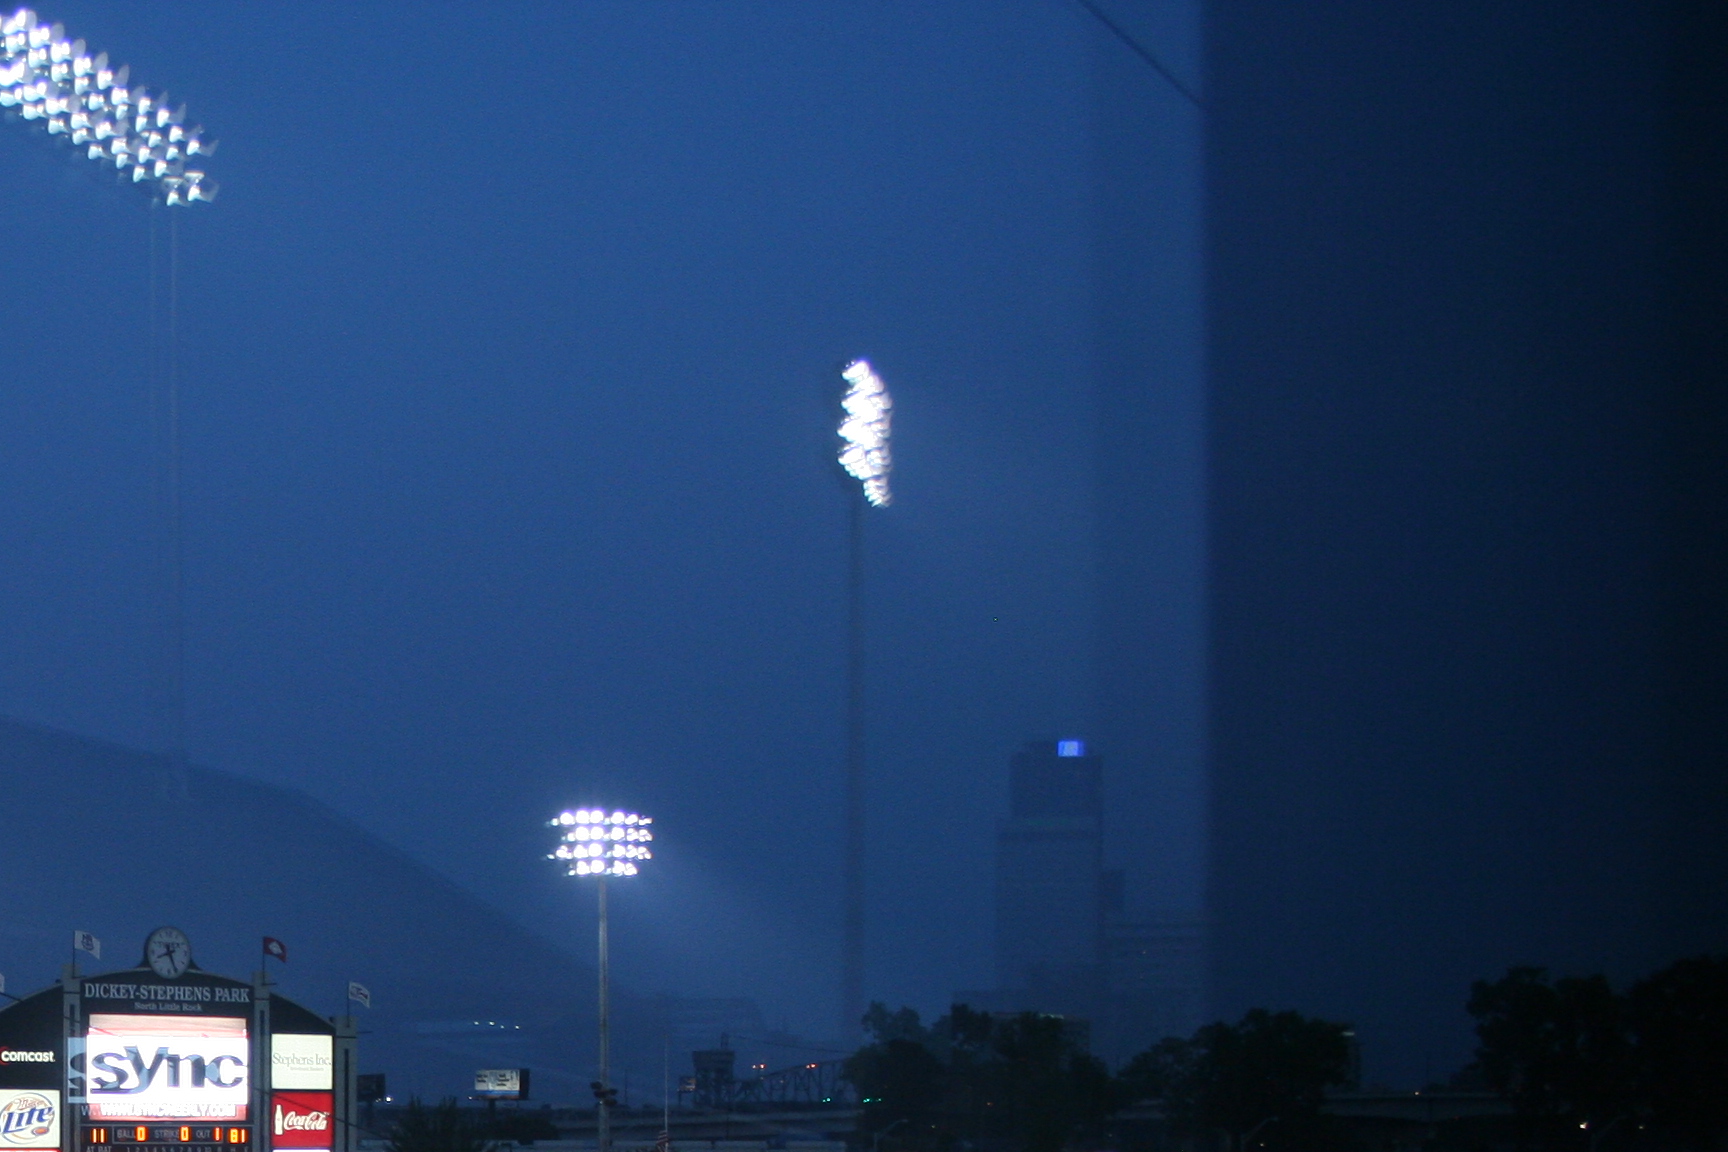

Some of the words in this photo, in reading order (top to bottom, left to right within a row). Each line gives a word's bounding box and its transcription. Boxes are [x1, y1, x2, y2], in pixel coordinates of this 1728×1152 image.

[84, 982, 211, 1001] DICKEY-STEPHENS
[215, 988, 250, 1003] PARK
[134, 1002, 157, 1010] North
[159, 1002, 180, 1011] Little
[182, 1003, 202, 1012] Rock
[272, 1053, 314, 1067] Stephens
[90, 1045, 244, 1094] sync
[1, 1106, 54, 1134] Lite
[137, 1126, 146, 1141] 0
[181, 1126, 190, 1141] 0
[196, 1130, 211, 1139] OUT
